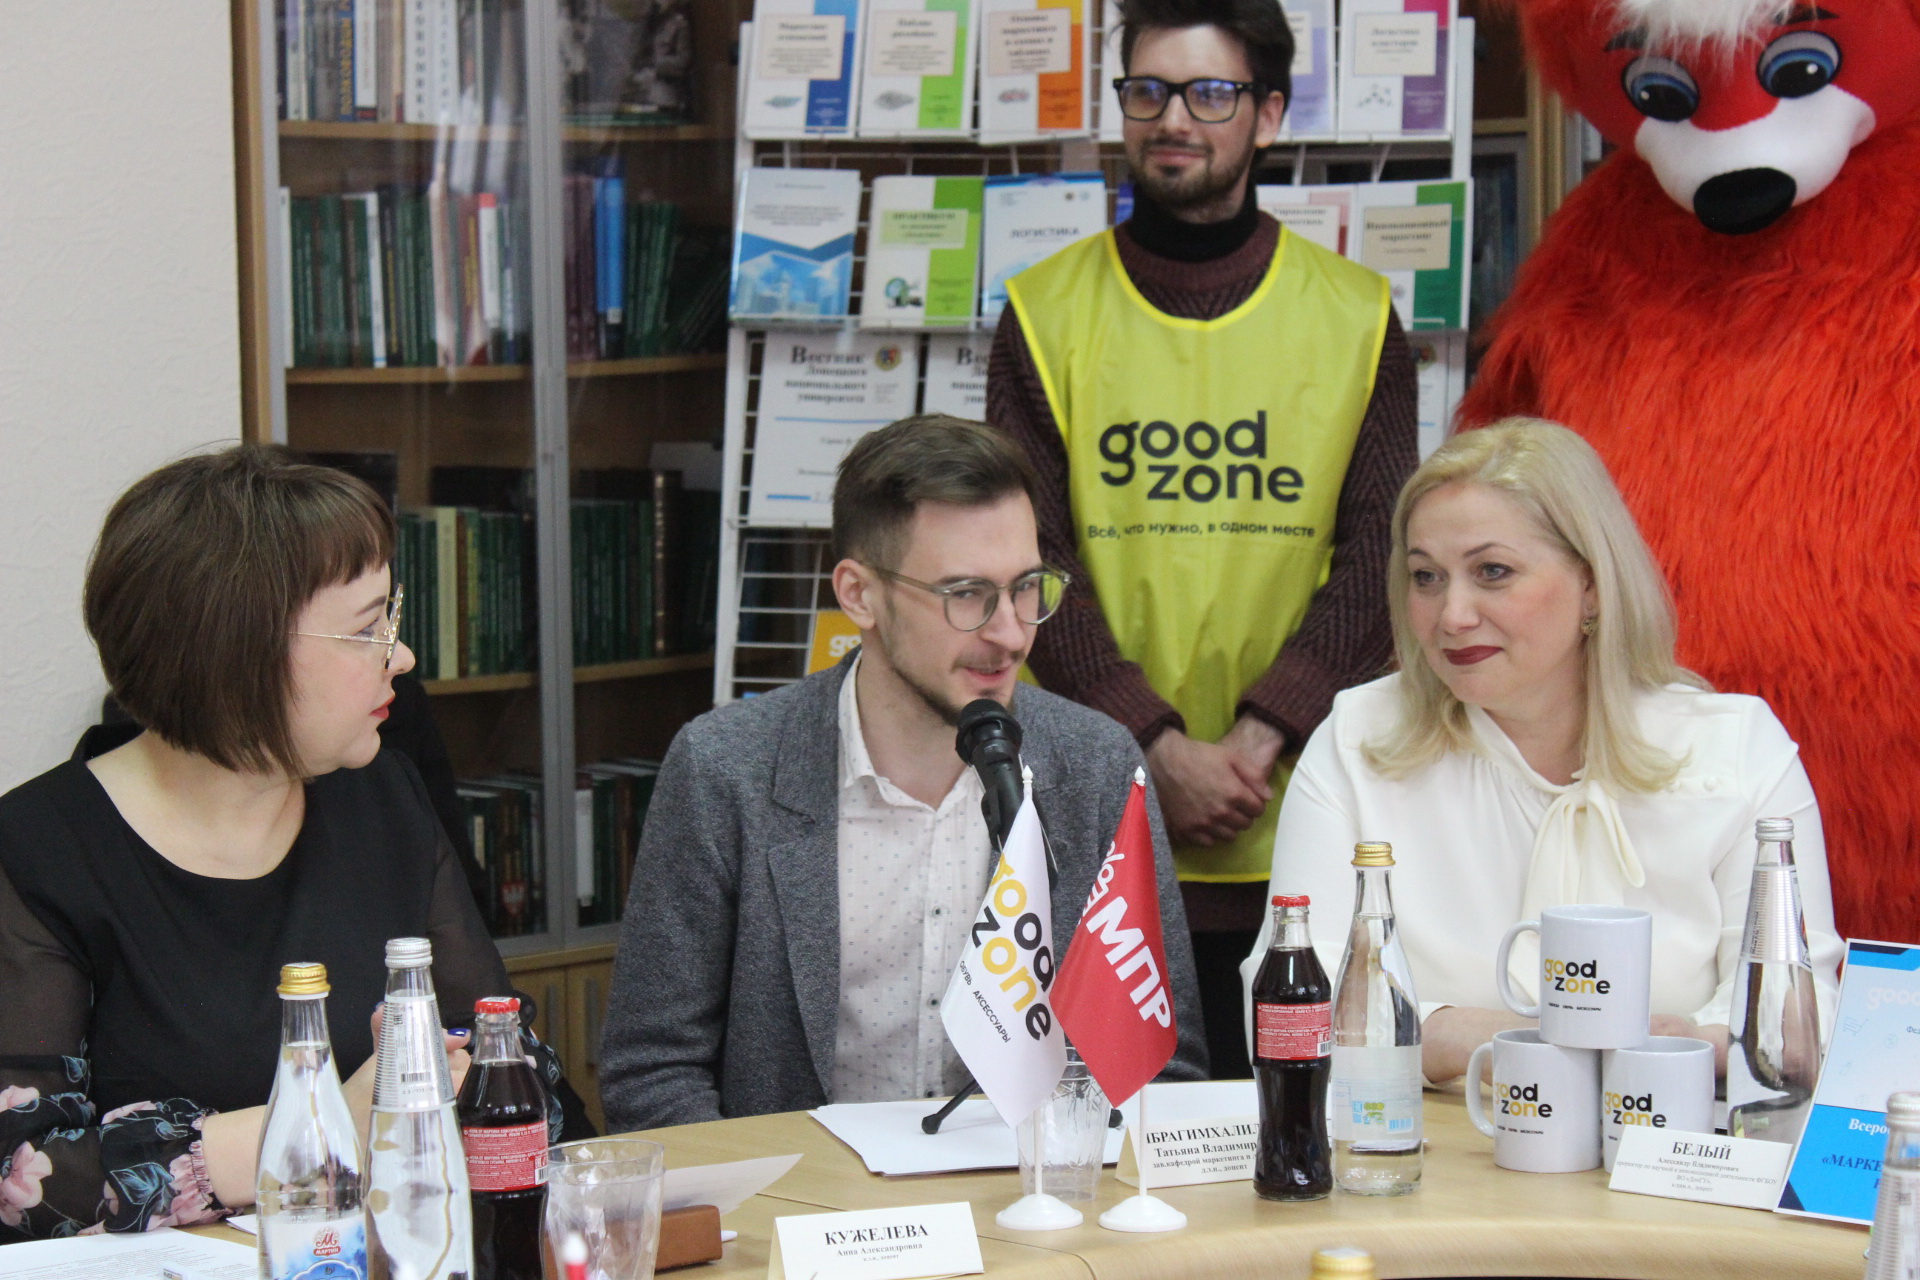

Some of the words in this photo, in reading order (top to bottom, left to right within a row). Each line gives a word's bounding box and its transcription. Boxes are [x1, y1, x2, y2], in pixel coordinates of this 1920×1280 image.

[1010, 227, 1080, 239] ЛОГИСТИКА
[791, 345, 866, 365] Вестник
[1099, 410, 1267, 486] good
[1147, 463, 1304, 503] zone
[1088, 524, 1121, 540] Всё,
[1124, 524, 1145, 535] что
[1149, 523, 1203, 536] нужно,
[1208, 523, 1216, 533] в
[1220, 521, 1268, 534] одном
[1272, 524, 1316, 538] месте
[1085, 895, 1171, 1028] МПР
[1544, 959, 1598, 982] good
[971, 905, 1051, 1041] zone
[1554, 976, 1611, 995] zone
[973, 990, 1011, 1043] АКСЕССУАРЫ
[1501, 1099, 1553, 1118] zone
[1604, 1091, 1653, 1115] good
[1613, 1109, 1667, 1129] zone
[1154, 1146, 1200, 1158] Татьяна
[1202, 1155, 1245, 1166] маркетинга
[1672, 1141, 1732, 1160] БЕЛЫЙ
[824, 1223, 929, 1246] КУЖЕЛЕВА
[315, 1247, 339, 1255] МАРТИН
[836, 1248, 859, 1257] Анна
[860, 1243, 923, 1255] Александровна
